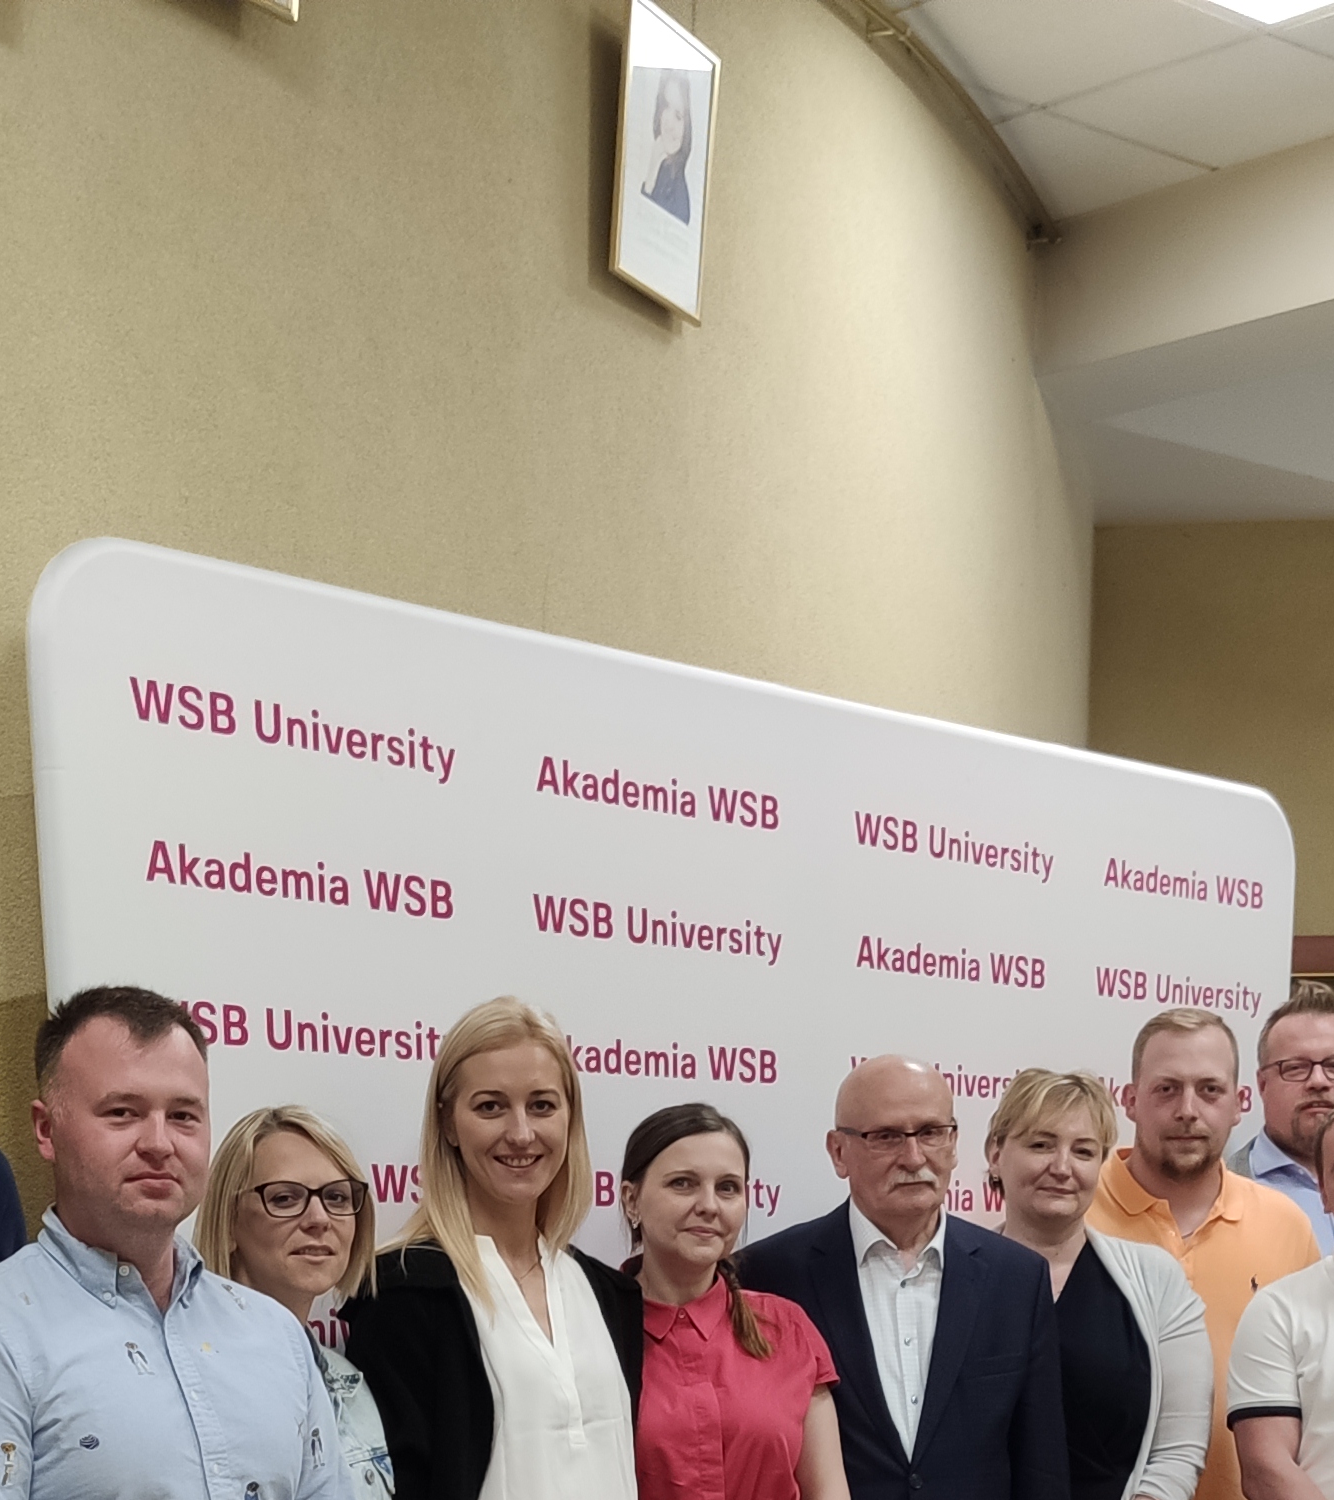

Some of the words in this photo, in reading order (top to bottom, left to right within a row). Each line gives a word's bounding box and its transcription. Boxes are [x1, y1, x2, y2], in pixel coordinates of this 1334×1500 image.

[129, 676, 237, 736] WSB
[253, 699, 456, 785] University
[536, 755, 698, 818] Akademia
[708, 786, 780, 831] WSB
[146, 839, 350, 906] Akademia
[363, 868, 455, 920] WSB
[855, 811, 919, 854] WSB
[928, 826, 1054, 882] University
[1104, 857, 1208, 902] Akademia
[1216, 876, 1264, 910] WSB
[532, 893, 615, 940] WSB
[626, 906, 783, 966] University
[856, 935, 980, 982] Akademia
[990, 953, 1046, 989] WSB
[1096, 966, 1147, 1001] WSB
[1156, 973, 1262, 1018] University
[178, 1000, 249, 1047] SB
[265, 1007, 441, 1061] Universit
[565, 1034, 697, 1080] kademia
[707, 1045, 777, 1084] WSB
